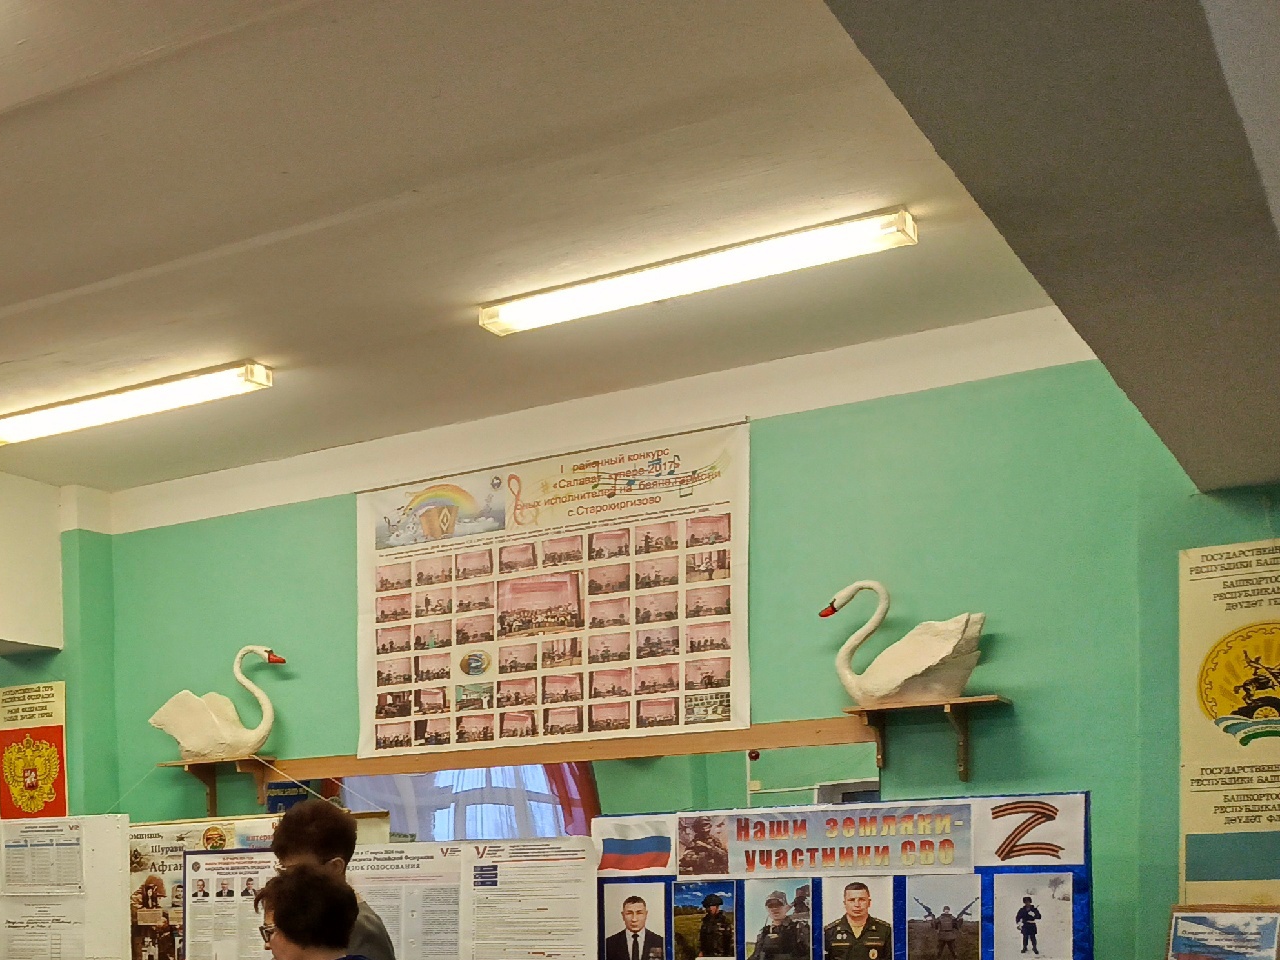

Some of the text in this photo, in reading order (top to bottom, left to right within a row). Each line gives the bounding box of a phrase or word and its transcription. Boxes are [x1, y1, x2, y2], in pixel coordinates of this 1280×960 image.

[627, 448, 670, 462] конкурс
[544, 486, 617, 506] исполнителей
[736, 817, 808, 842] Наши
[744, 838, 955, 873] участники СВО
